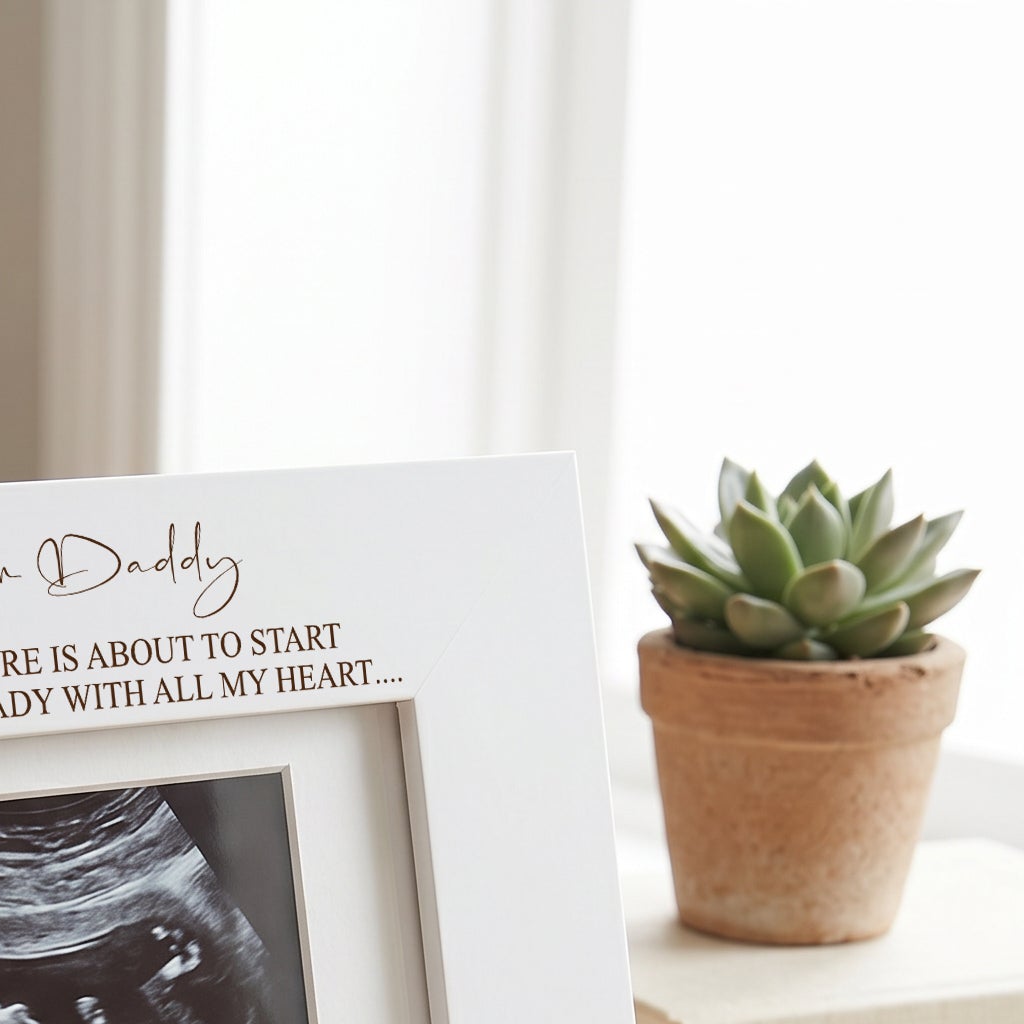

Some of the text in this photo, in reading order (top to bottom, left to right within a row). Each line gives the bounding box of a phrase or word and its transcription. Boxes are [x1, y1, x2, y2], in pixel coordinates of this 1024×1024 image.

[36, 520, 243, 619] Daddy
[49, 643, 79, 674] IS
[86, 634, 195, 670] ABOUT
[200, 630, 242, 660] TO
[250, 622, 341, 657] START
[60, 679, 147, 713] WITH
[152, 674, 214, 704] ALL
[218, 667, 269, 699] MY
[274, 658, 403, 693] HEART....
